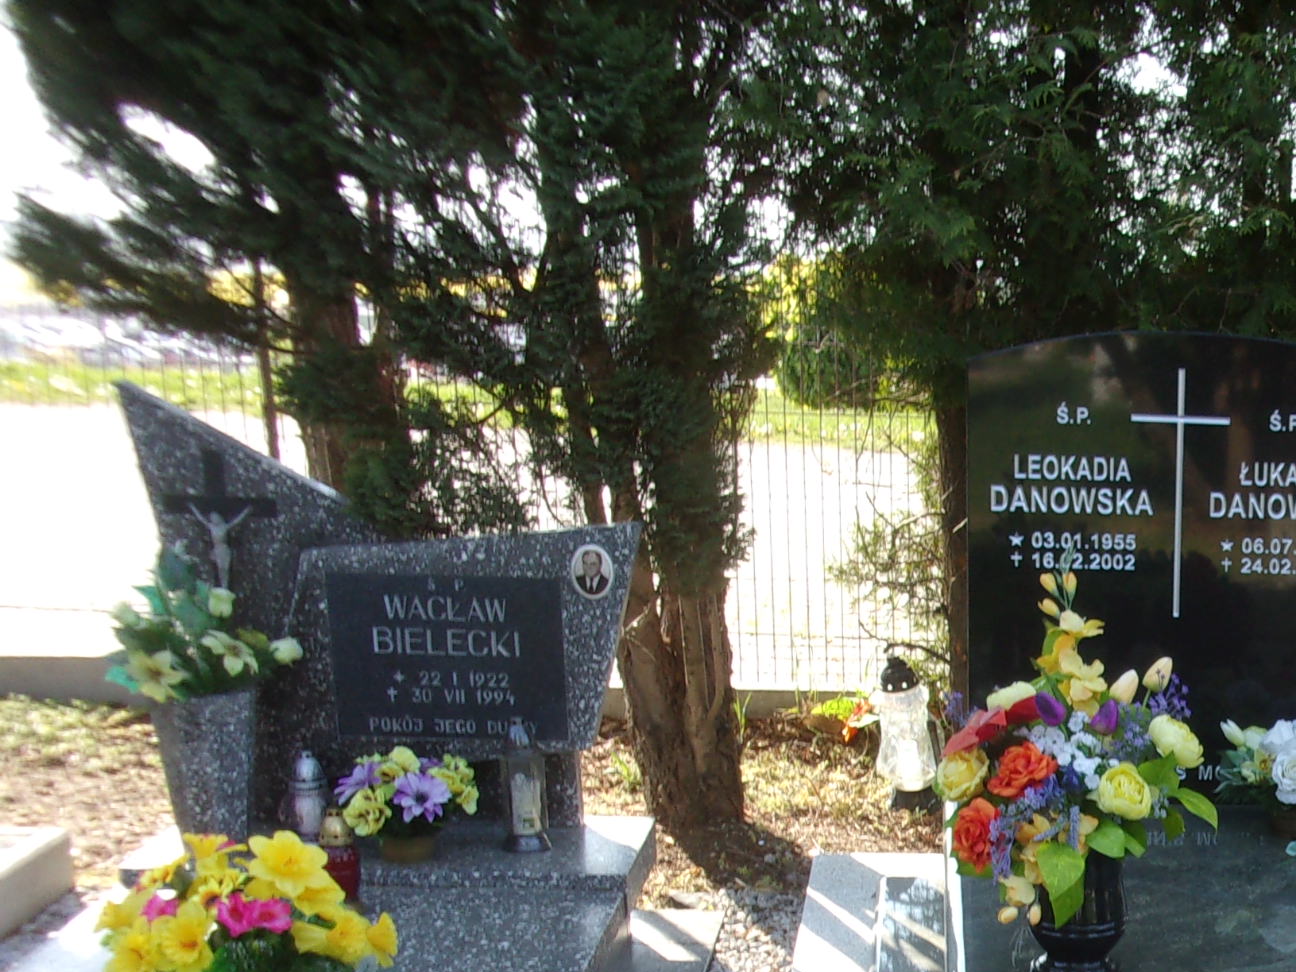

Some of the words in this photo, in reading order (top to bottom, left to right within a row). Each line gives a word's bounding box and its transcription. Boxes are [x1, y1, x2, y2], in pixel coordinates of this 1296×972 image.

[1013, 453, 1132, 482] LEOKADIA
[990, 484, 1154, 516] DANOWSKA
[1031, 531, 1137, 551] 03.01.1955
[383, 593, 507, 623] WACŁAW
[371, 625, 522, 658] BIELECKI
[419, 671, 441, 686] 22
[469, 670, 510, 689] 1922
[411, 687, 432, 704] 30
[443, 688, 466, 705] VII
[477, 688, 516, 706] 1994
[369, 714, 424, 733] POKÓJ
[433, 718, 477, 735] JEGO
